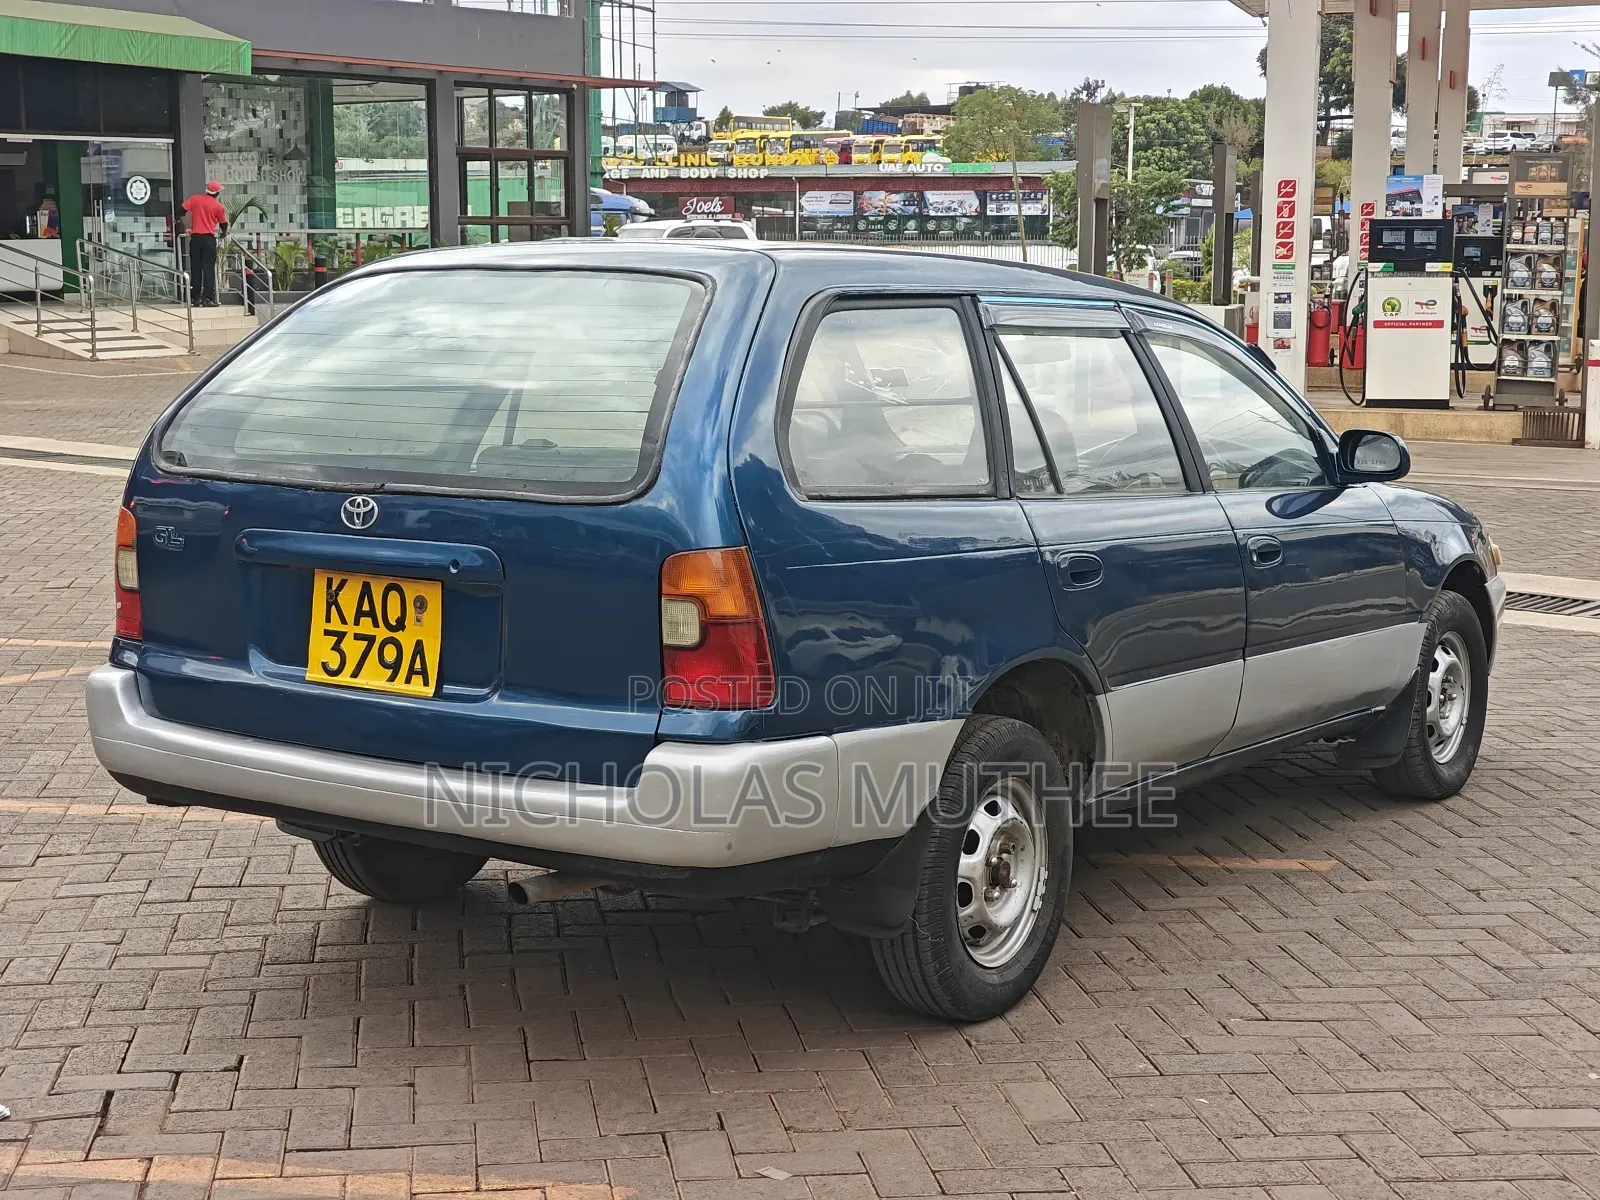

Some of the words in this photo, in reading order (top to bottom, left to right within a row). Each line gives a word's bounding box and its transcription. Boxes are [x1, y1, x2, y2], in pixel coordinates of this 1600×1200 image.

[654, 152, 720, 167] CLINIC
[271, 168, 307, 184] SHOW
[641, 168, 669, 179] AND
[680, 168, 719, 179] BODY
[727, 168, 769, 179] SHOP
[879, 163, 902, 172] UAE
[907, 163, 944, 173] AUTO
[682, 197, 725, 216] Joels
[325, 576, 407, 633] KAQ
[320, 628, 430, 688] 379A
